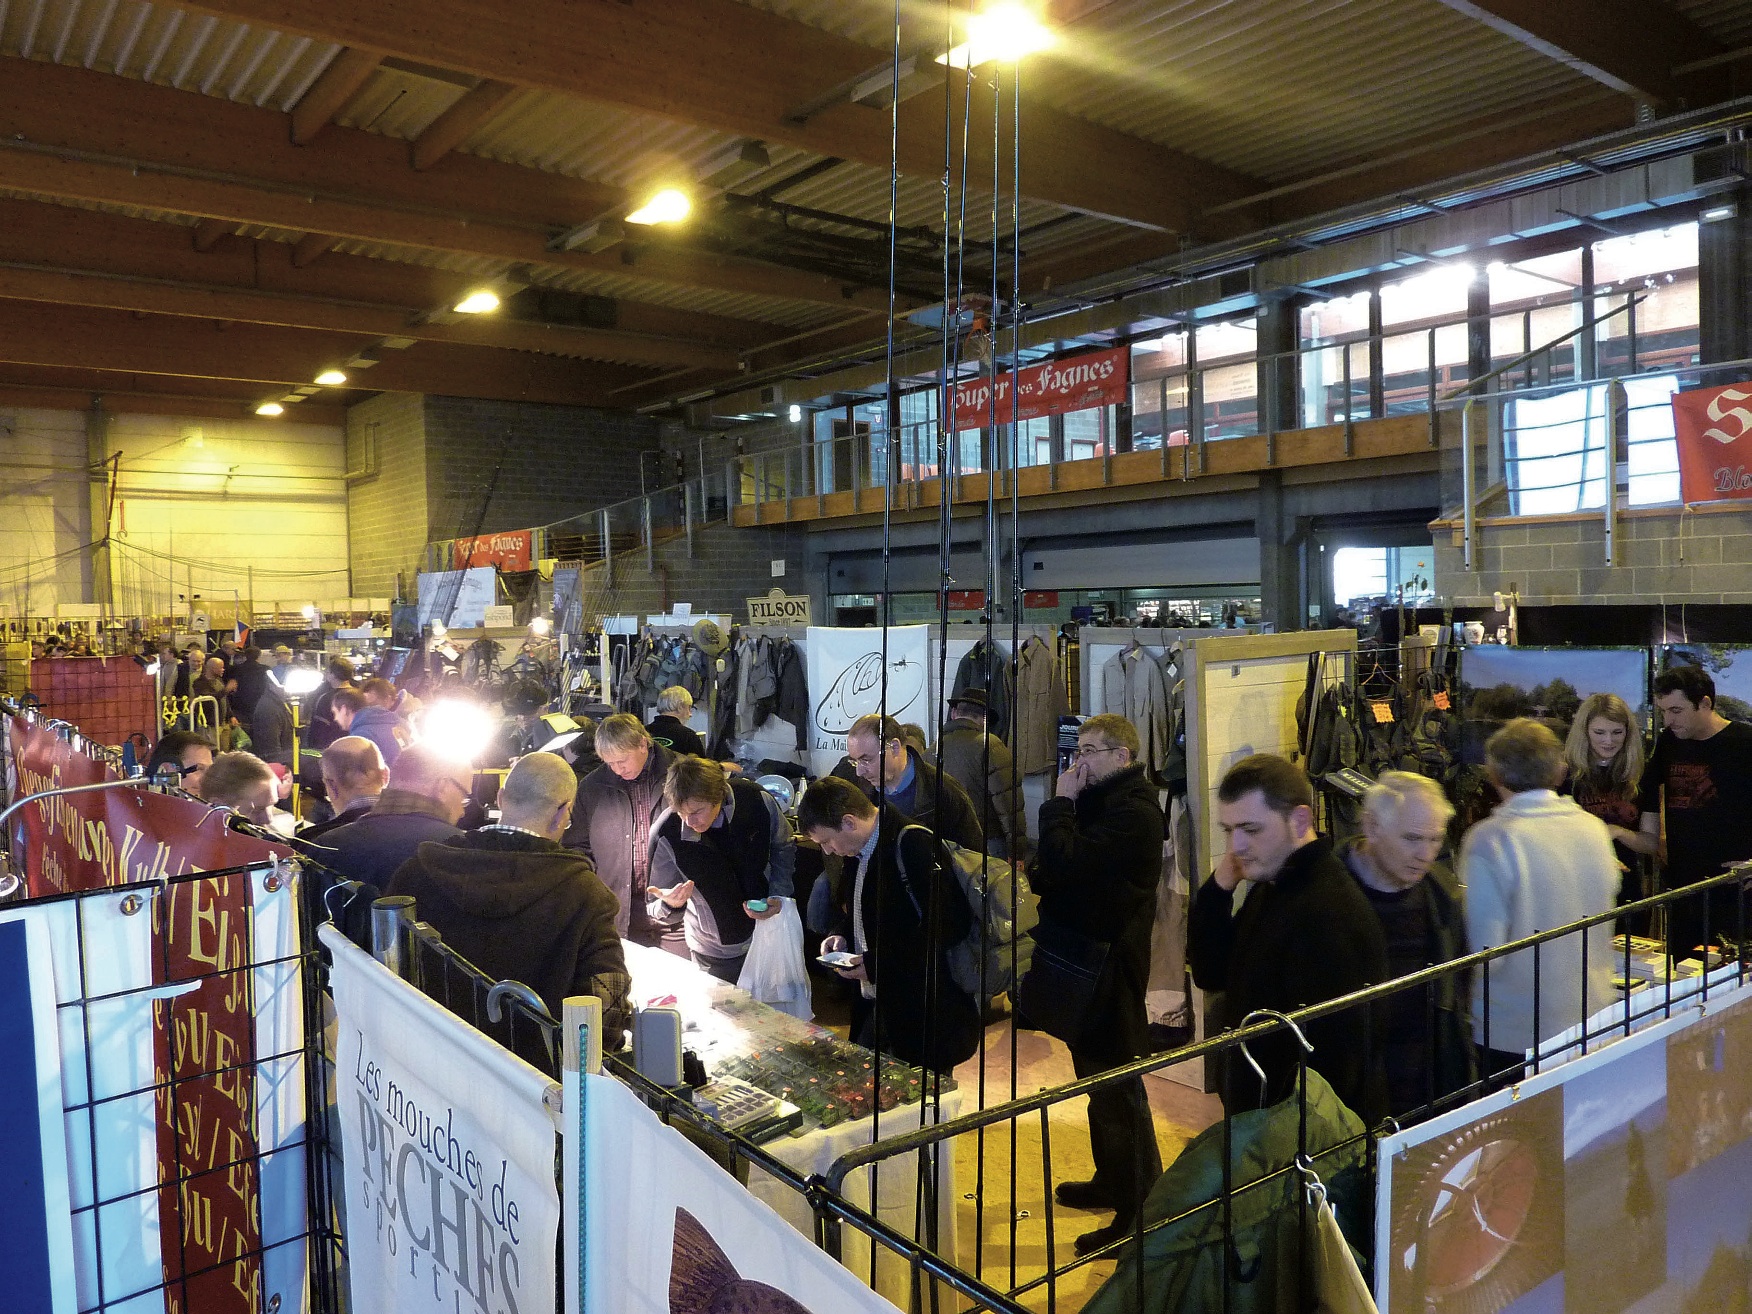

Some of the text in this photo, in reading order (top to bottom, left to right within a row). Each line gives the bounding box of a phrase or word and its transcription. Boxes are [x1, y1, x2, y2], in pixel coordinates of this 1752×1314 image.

[1037, 361, 1114, 396] Fagnes
[751, 601, 807, 617] FILSON
[355, 1029, 520, 1245] Les mouches de
